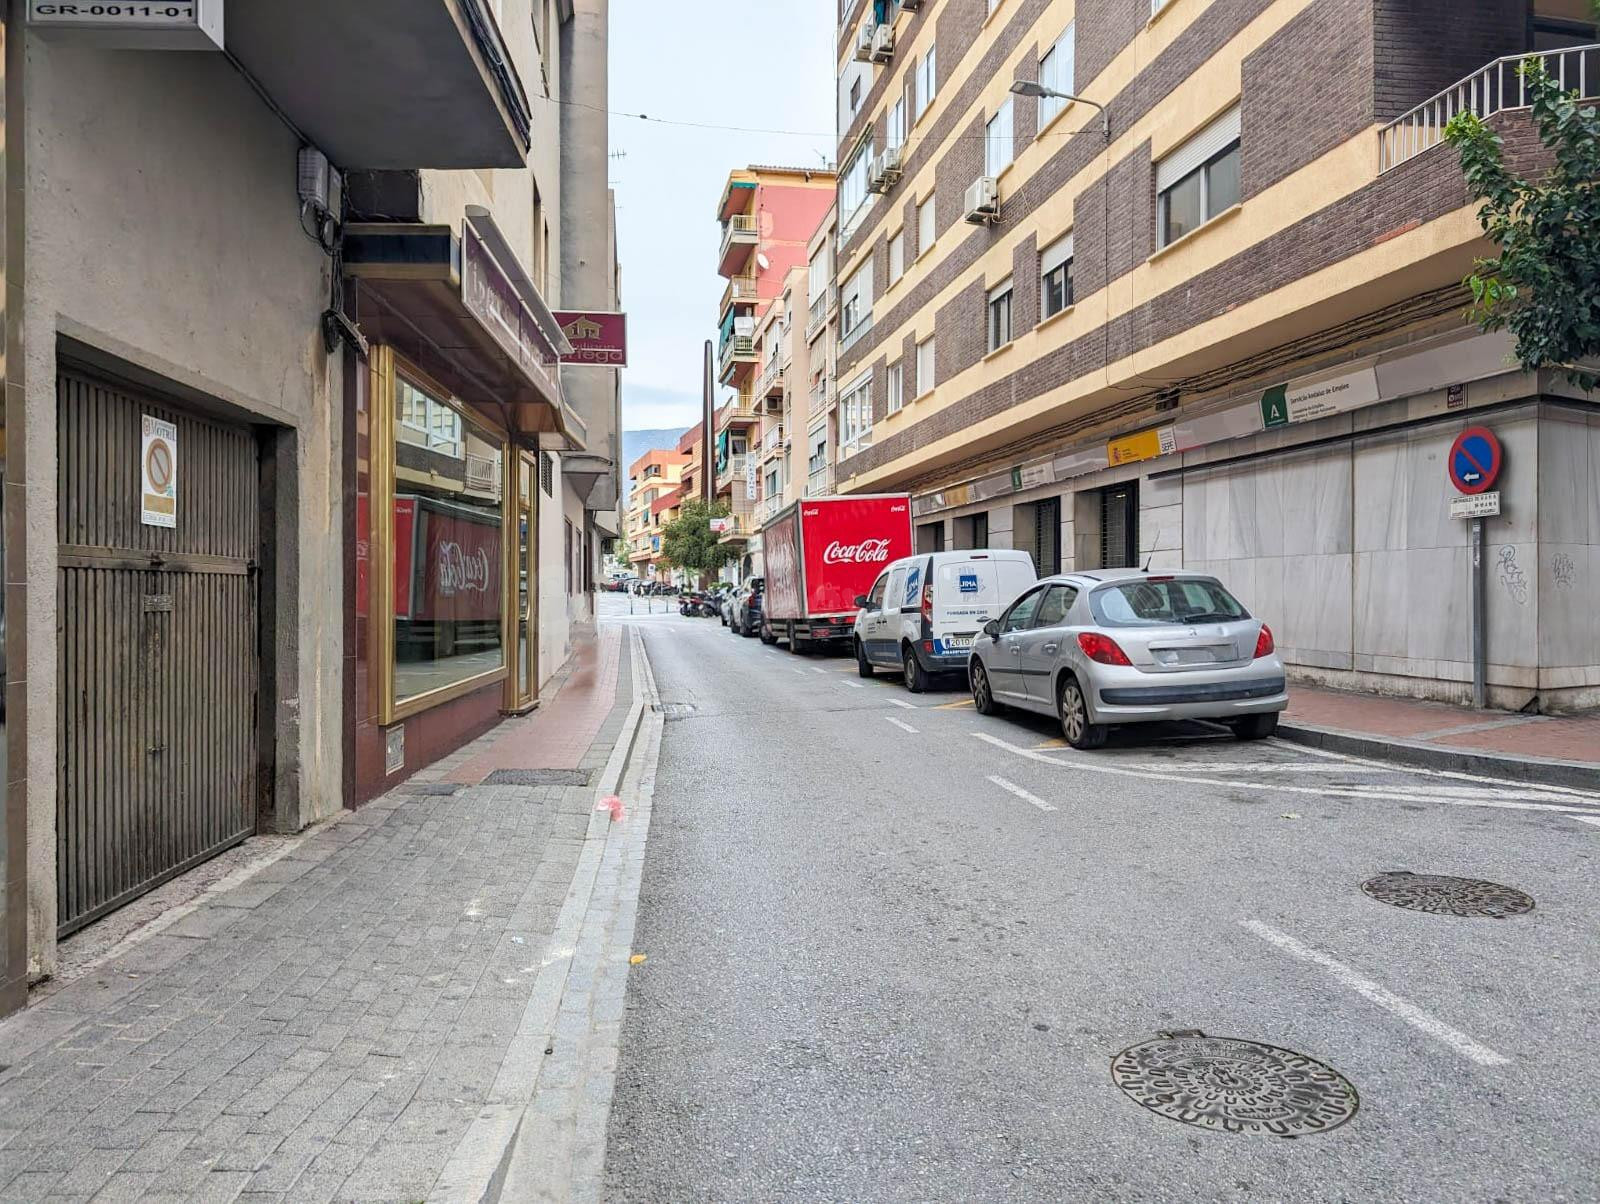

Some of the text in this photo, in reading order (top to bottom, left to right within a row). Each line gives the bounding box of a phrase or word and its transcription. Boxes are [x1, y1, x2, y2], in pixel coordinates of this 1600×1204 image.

[36, 5, 192, 17] GR-0011-01
[1332, 383, 1350, 393] Empleo
[823, 539, 891, 564] Coca-Cola
